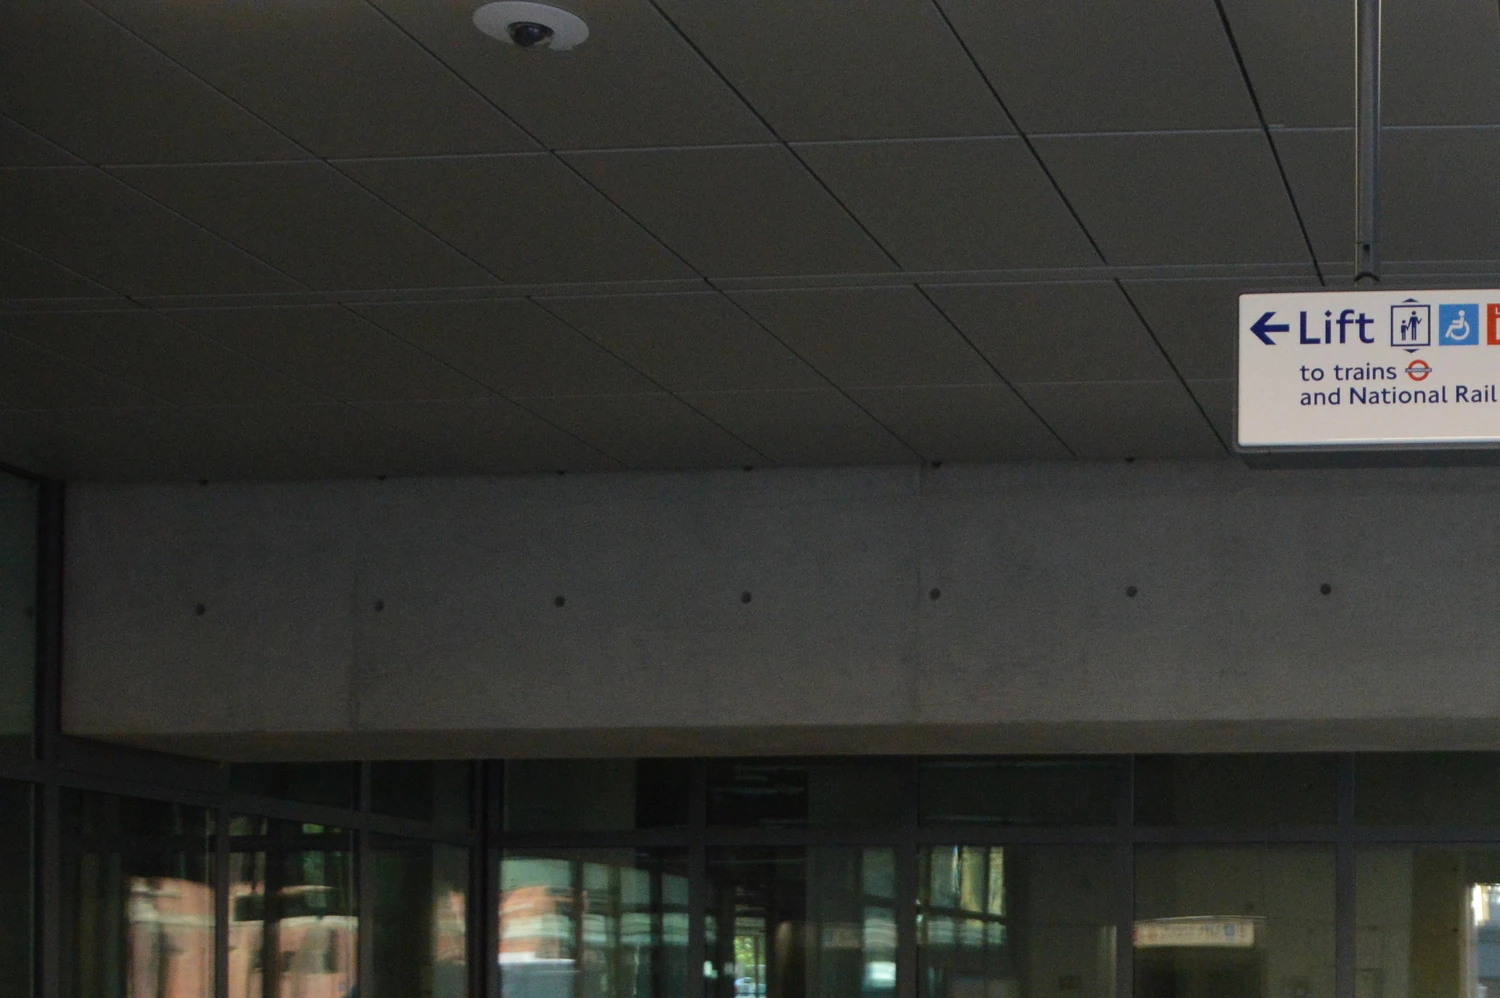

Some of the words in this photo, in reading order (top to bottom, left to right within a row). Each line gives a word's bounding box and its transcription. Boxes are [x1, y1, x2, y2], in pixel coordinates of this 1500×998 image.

[1300, 309, 1375, 345] Lift
[1300, 365, 1324, 381] to
[1333, 362, 1397, 380] trains
[1300, 387, 1341, 405] and
[1350, 384, 1448, 404] National
[1455, 384, 1498, 403] Rail
